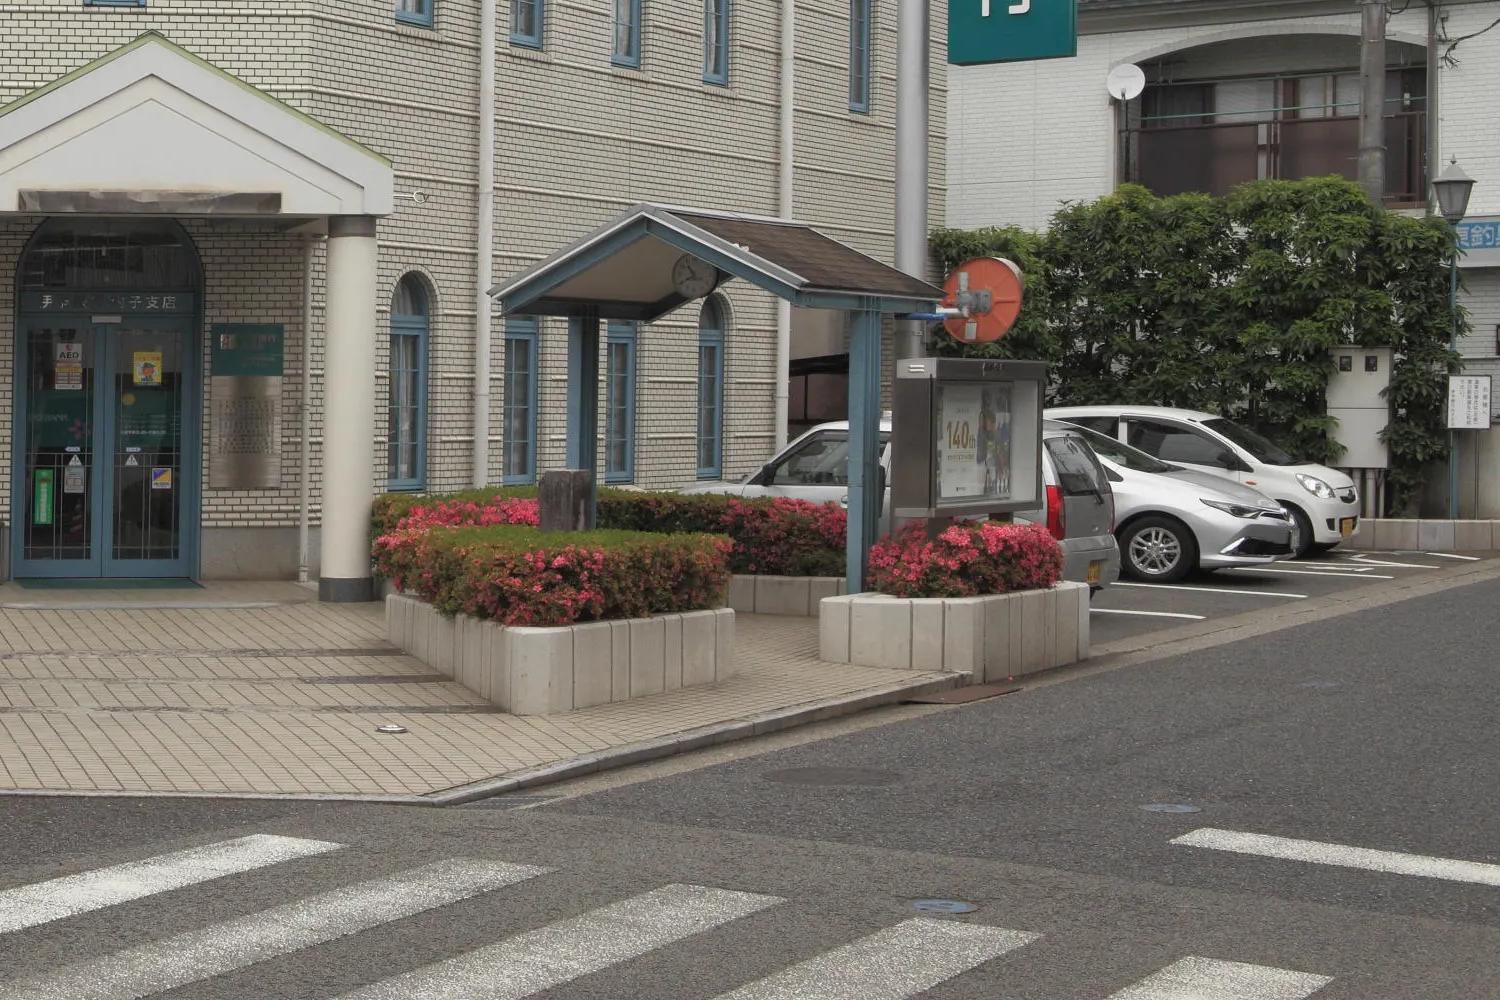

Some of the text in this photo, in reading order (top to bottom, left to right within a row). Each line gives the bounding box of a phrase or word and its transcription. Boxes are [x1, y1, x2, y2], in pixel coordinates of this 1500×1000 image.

[1456, 224, 1500, 247] 東釣
[59, 351, 80, 359] AED
[946, 420, 976, 450] 140th
